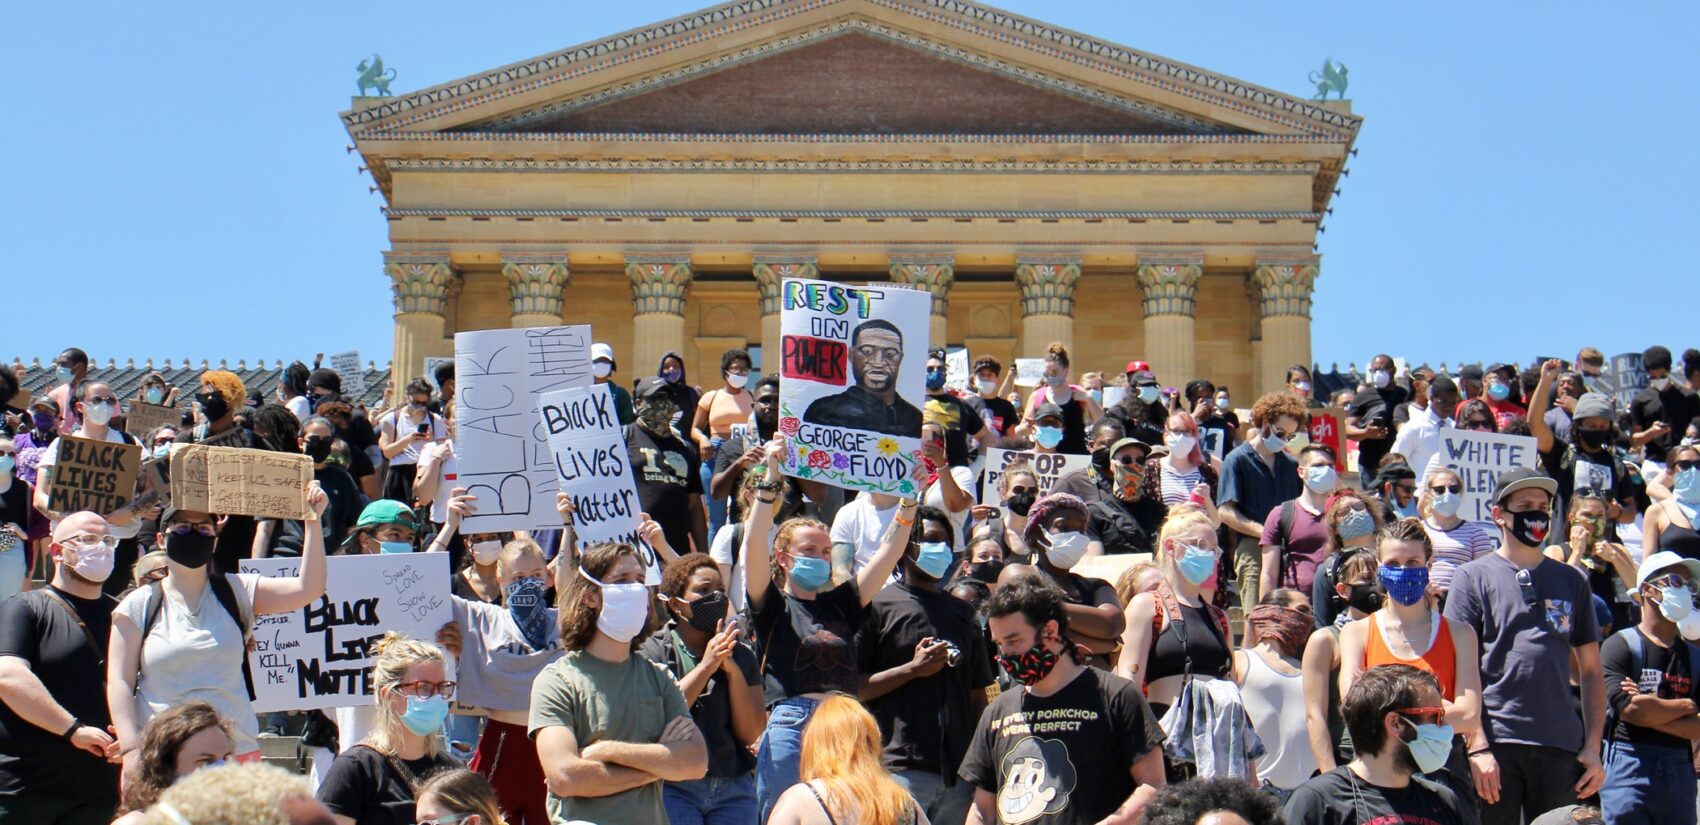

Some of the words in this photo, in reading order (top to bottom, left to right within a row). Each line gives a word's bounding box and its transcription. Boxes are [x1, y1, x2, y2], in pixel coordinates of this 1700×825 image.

[783, 281, 885, 319] REST
[811, 316, 849, 340] IN
[782, 335, 844, 380] POWER
[543, 392, 613, 435] Black
[461, 345, 532, 518] BLACK
[798, 424, 868, 453] GEORGE
[60, 439, 127, 472] BLACK
[188, 450, 256, 466] ABOLISH
[261, 455, 302, 471] POLICE
[556, 443, 623, 480] Lives
[1001, 450, 1066, 475] STOP
[1445, 438, 1525, 466] WHITE
[55, 465, 118, 494] LIVES
[185, 467, 209, 481] WE
[217, 472, 246, 483] KEEP
[248, 474, 266, 485] US
[644, 473, 669, 484] being
[850, 454, 906, 480] FLOYD
[395, 569, 425, 594] LOVE
[411, 595, 444, 622] LOVE
[259, 654, 292, 669] KILL
[296, 657, 376, 699] MATTE
[1002, 723, 1032, 738] WERE
[1033, 721, 1082, 733] PERFECT
[1003, 711, 1036, 727] EVERY
[1037, 708, 1099, 721] PORKCHOP
